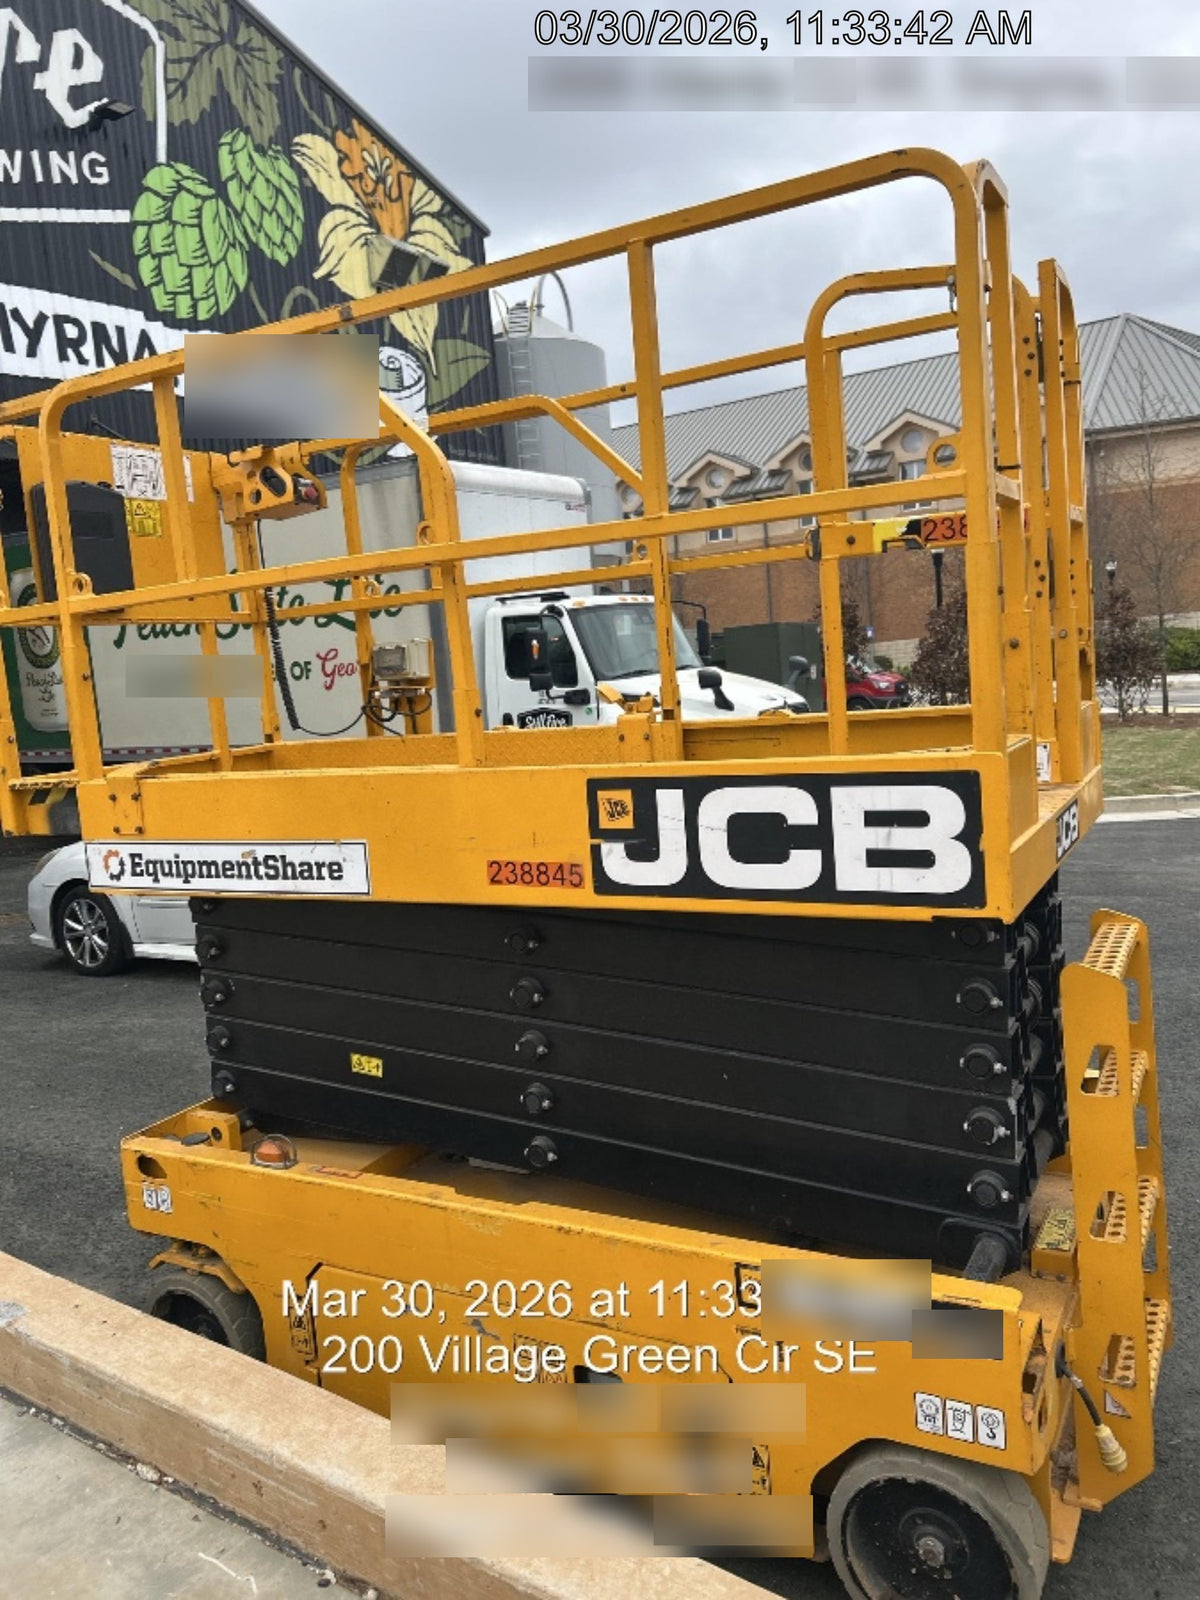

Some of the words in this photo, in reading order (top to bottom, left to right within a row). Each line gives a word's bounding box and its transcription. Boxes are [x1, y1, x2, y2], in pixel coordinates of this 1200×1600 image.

[290, 660, 312, 681] OF
[600, 784, 973, 894] JCB
[128, 852, 344, 884] EquipmentShare
[488, 861, 583, 888] 238845
